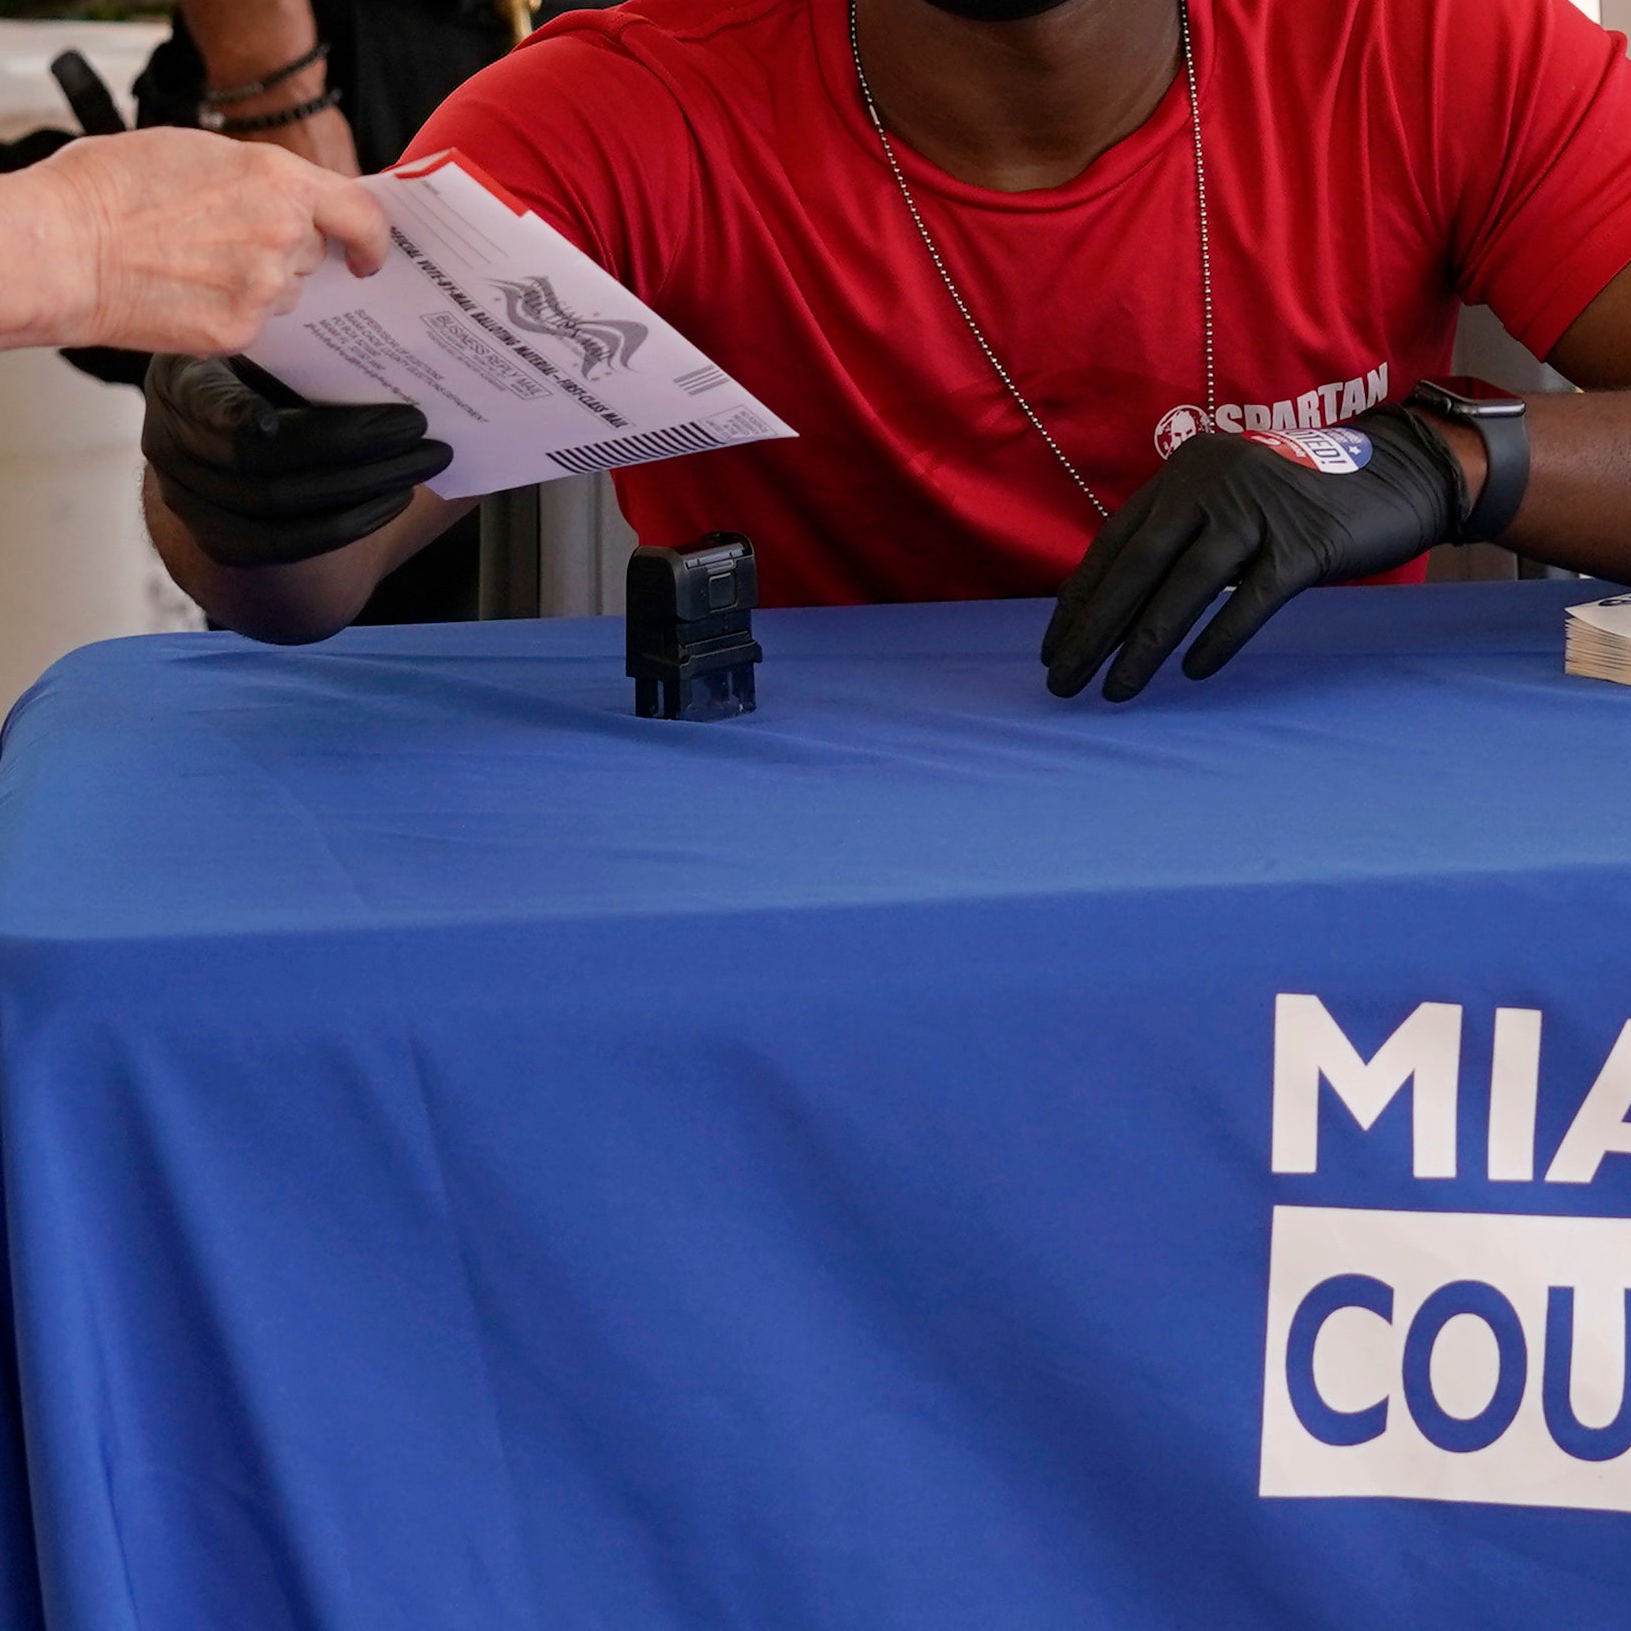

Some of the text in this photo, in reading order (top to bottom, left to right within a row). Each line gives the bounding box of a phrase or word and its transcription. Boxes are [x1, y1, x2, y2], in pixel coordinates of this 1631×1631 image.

[435, 313, 489, 358] BUSINESS
[471, 311, 522, 348] BALLOTING
[600, 410, 631, 429] MAIL
[1216, 361, 1388, 434] SPARTAN
